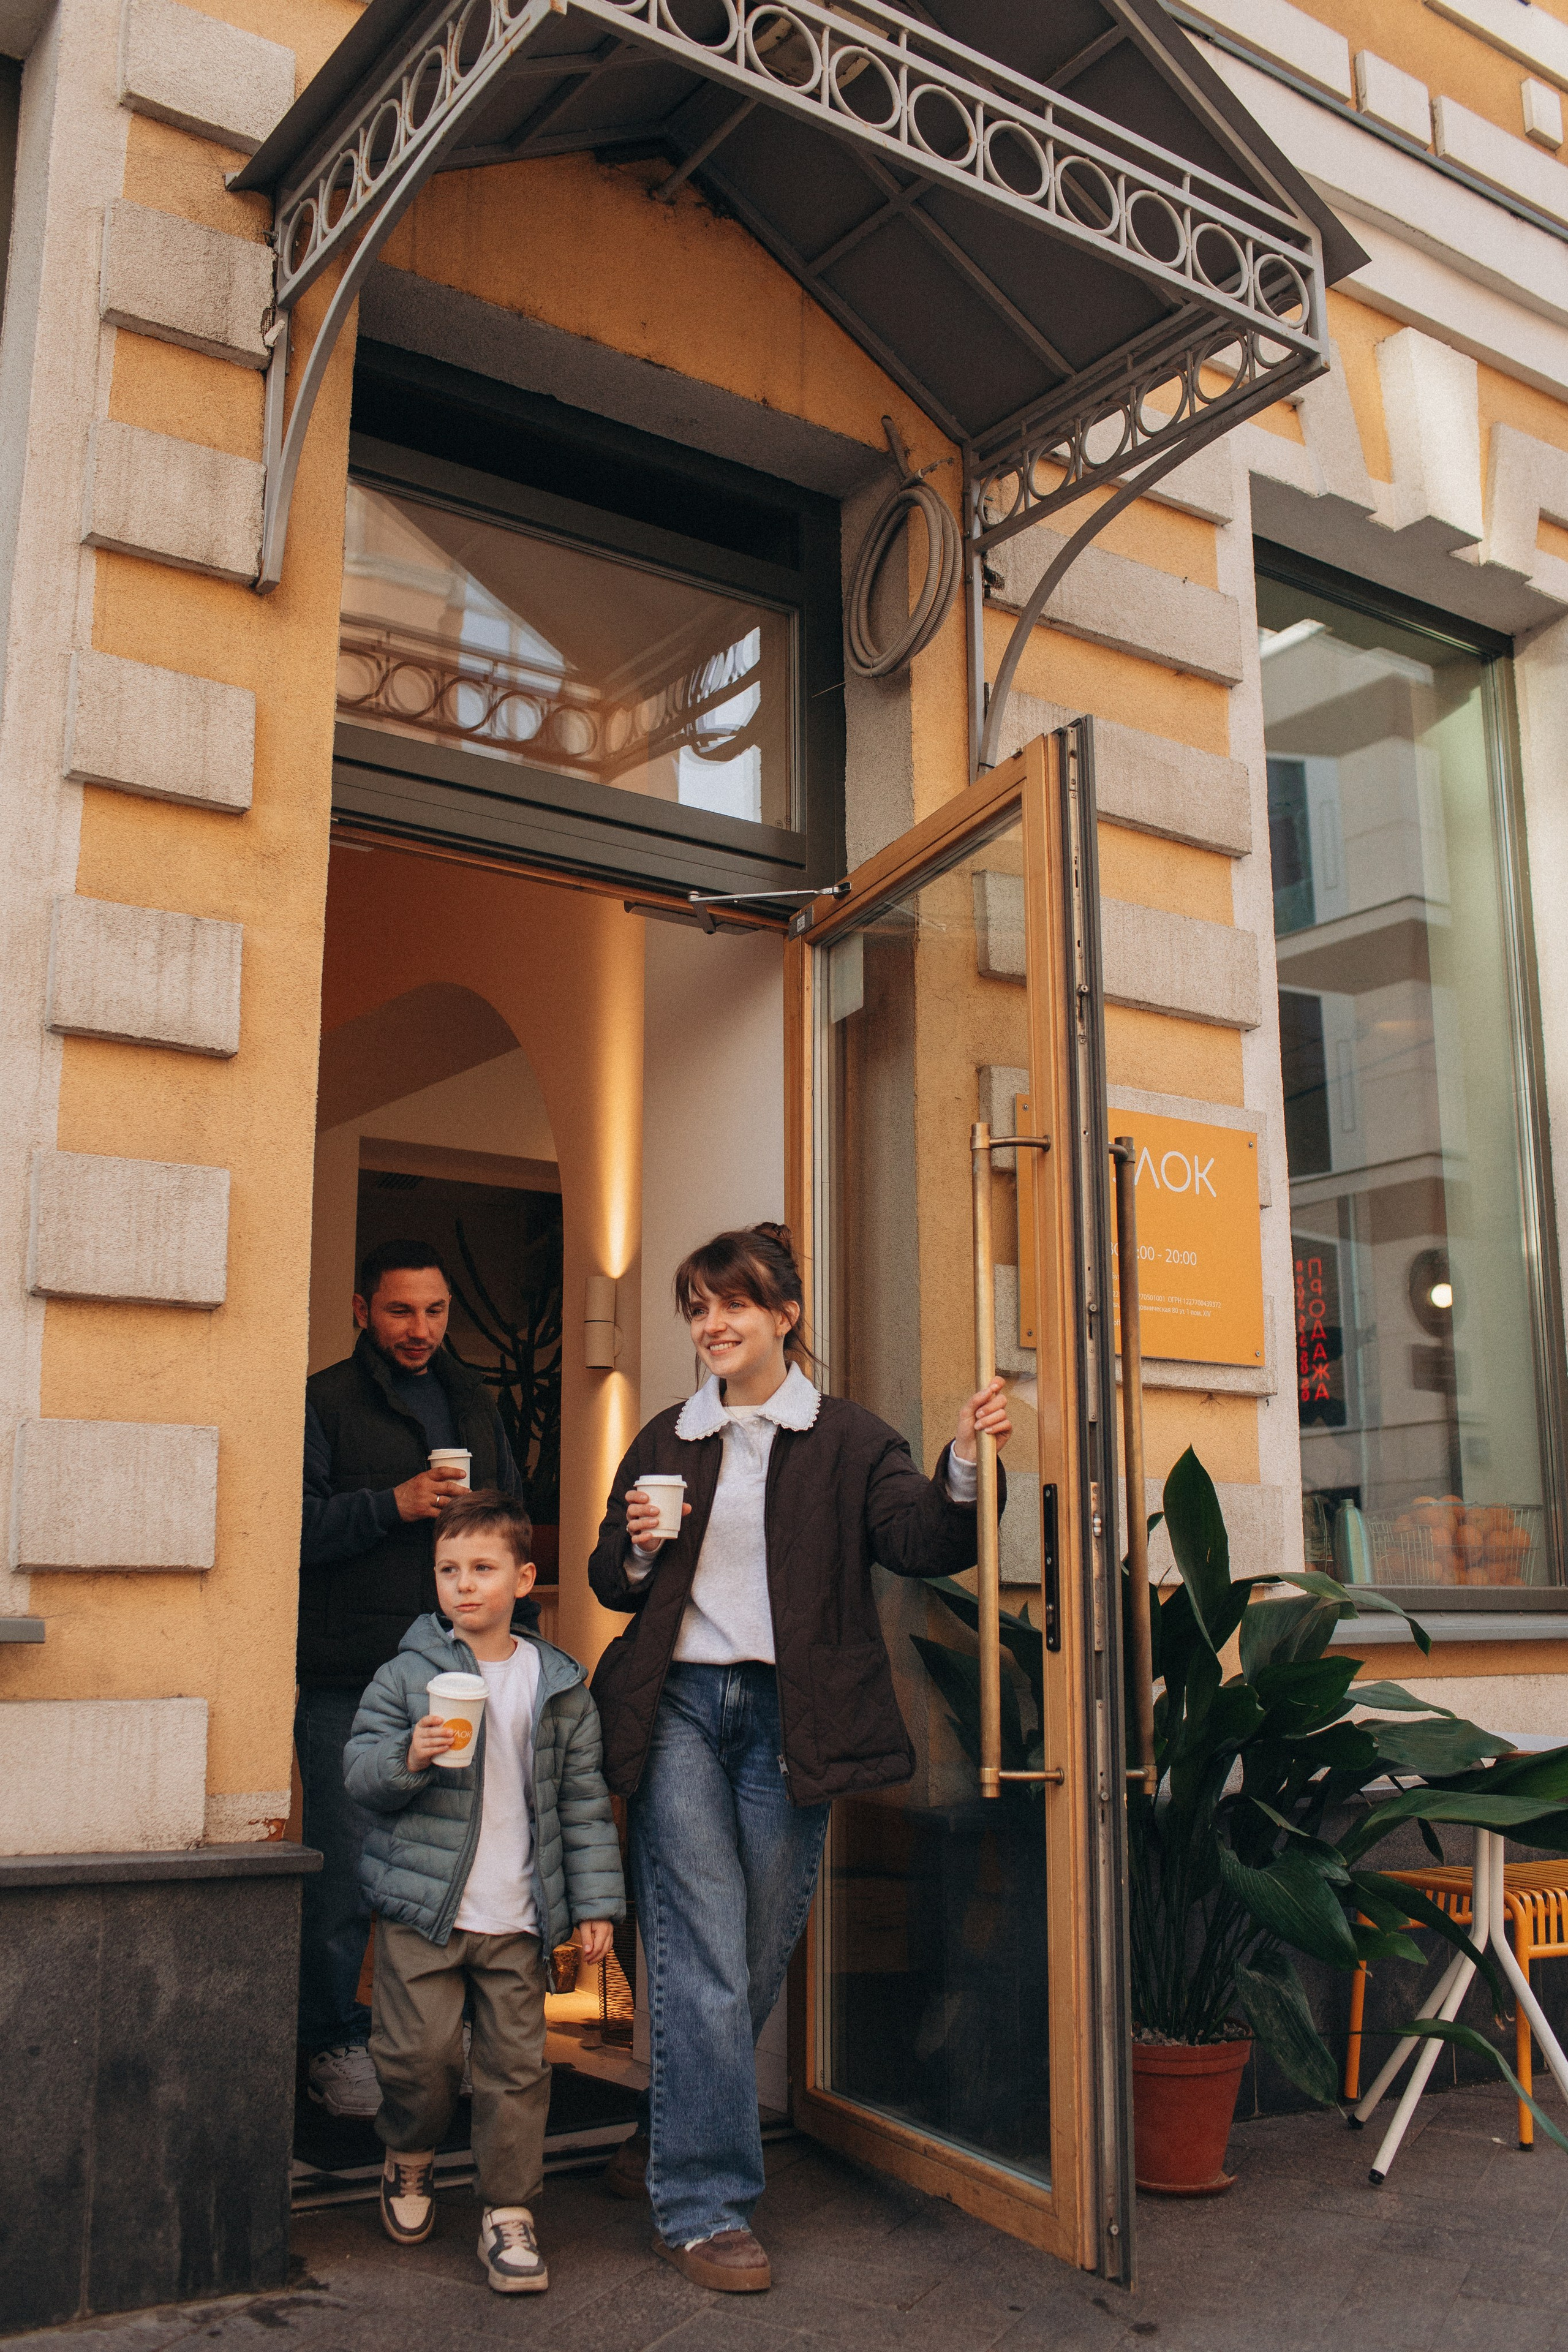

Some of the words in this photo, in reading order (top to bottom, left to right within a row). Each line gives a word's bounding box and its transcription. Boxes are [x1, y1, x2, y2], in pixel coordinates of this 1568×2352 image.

[1112, 1142, 1217, 1198] ЛОК
[1137, 1245, 1155, 1261] :00
[1165, 1248, 1197, 1266] 20:00
[1167, 1295, 1182, 1304] ОГРН
